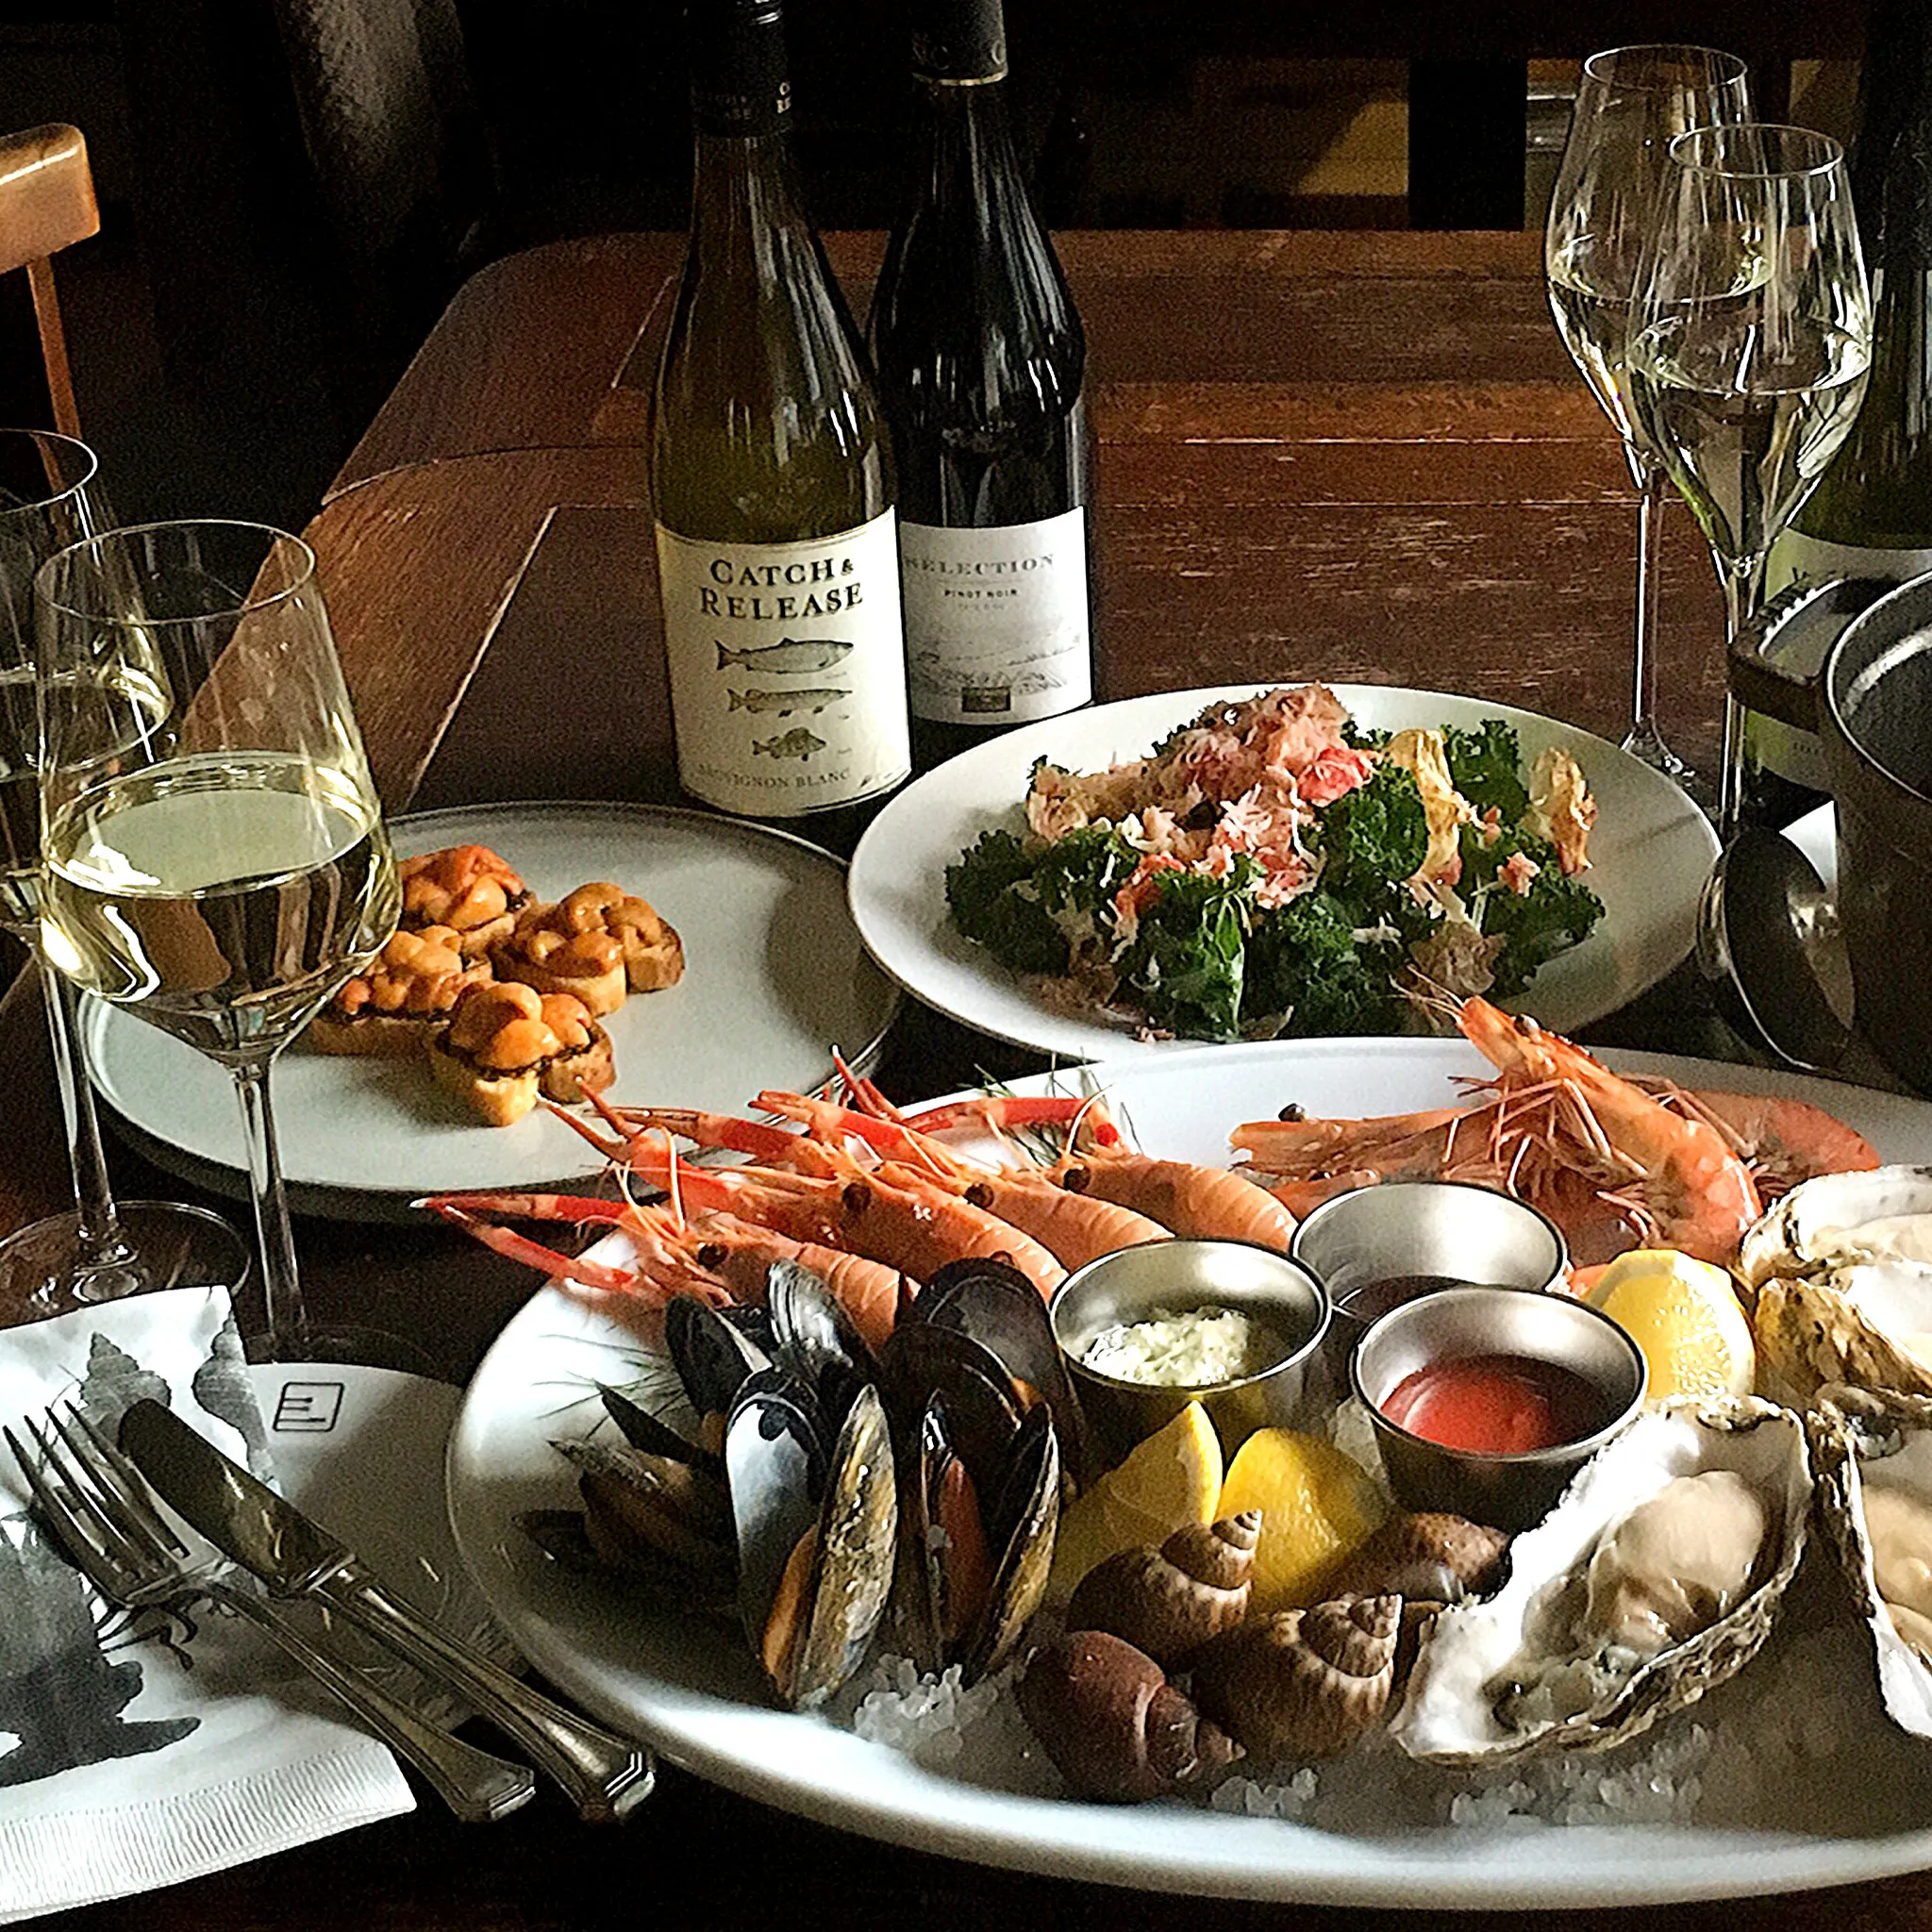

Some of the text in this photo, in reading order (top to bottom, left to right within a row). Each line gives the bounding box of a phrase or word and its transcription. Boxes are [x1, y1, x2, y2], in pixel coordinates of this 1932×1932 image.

[710, 558, 834, 586] CATCH
[701, 582, 863, 620] RELEASE
[795, 768, 851, 788] BLANC
